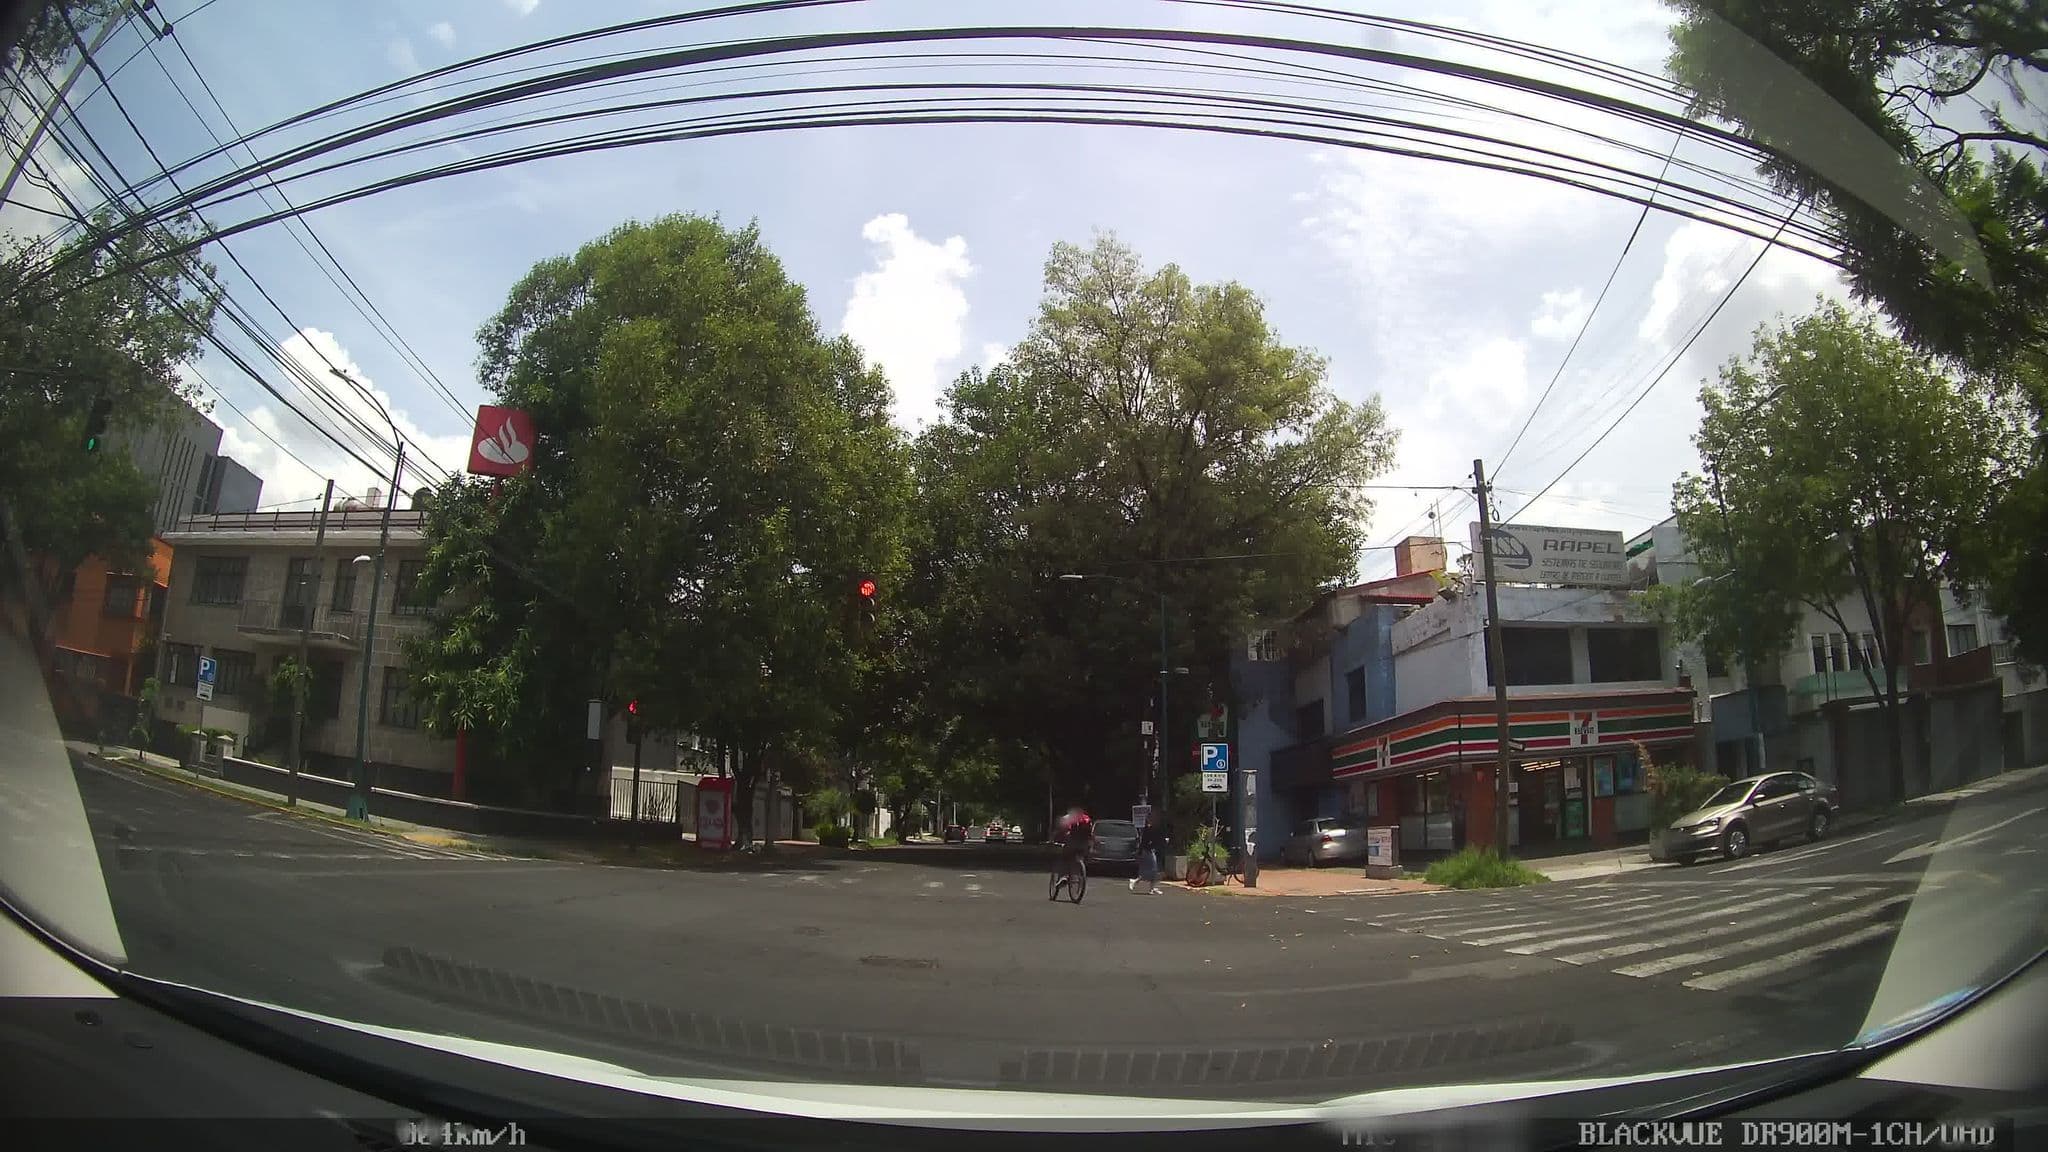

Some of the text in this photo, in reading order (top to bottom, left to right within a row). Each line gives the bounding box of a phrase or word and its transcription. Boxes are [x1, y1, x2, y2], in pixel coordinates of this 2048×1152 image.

[1543, 539, 1621, 554] RAPEL
[200, 660, 210, 676] P
[1203, 746, 1218, 765] P
